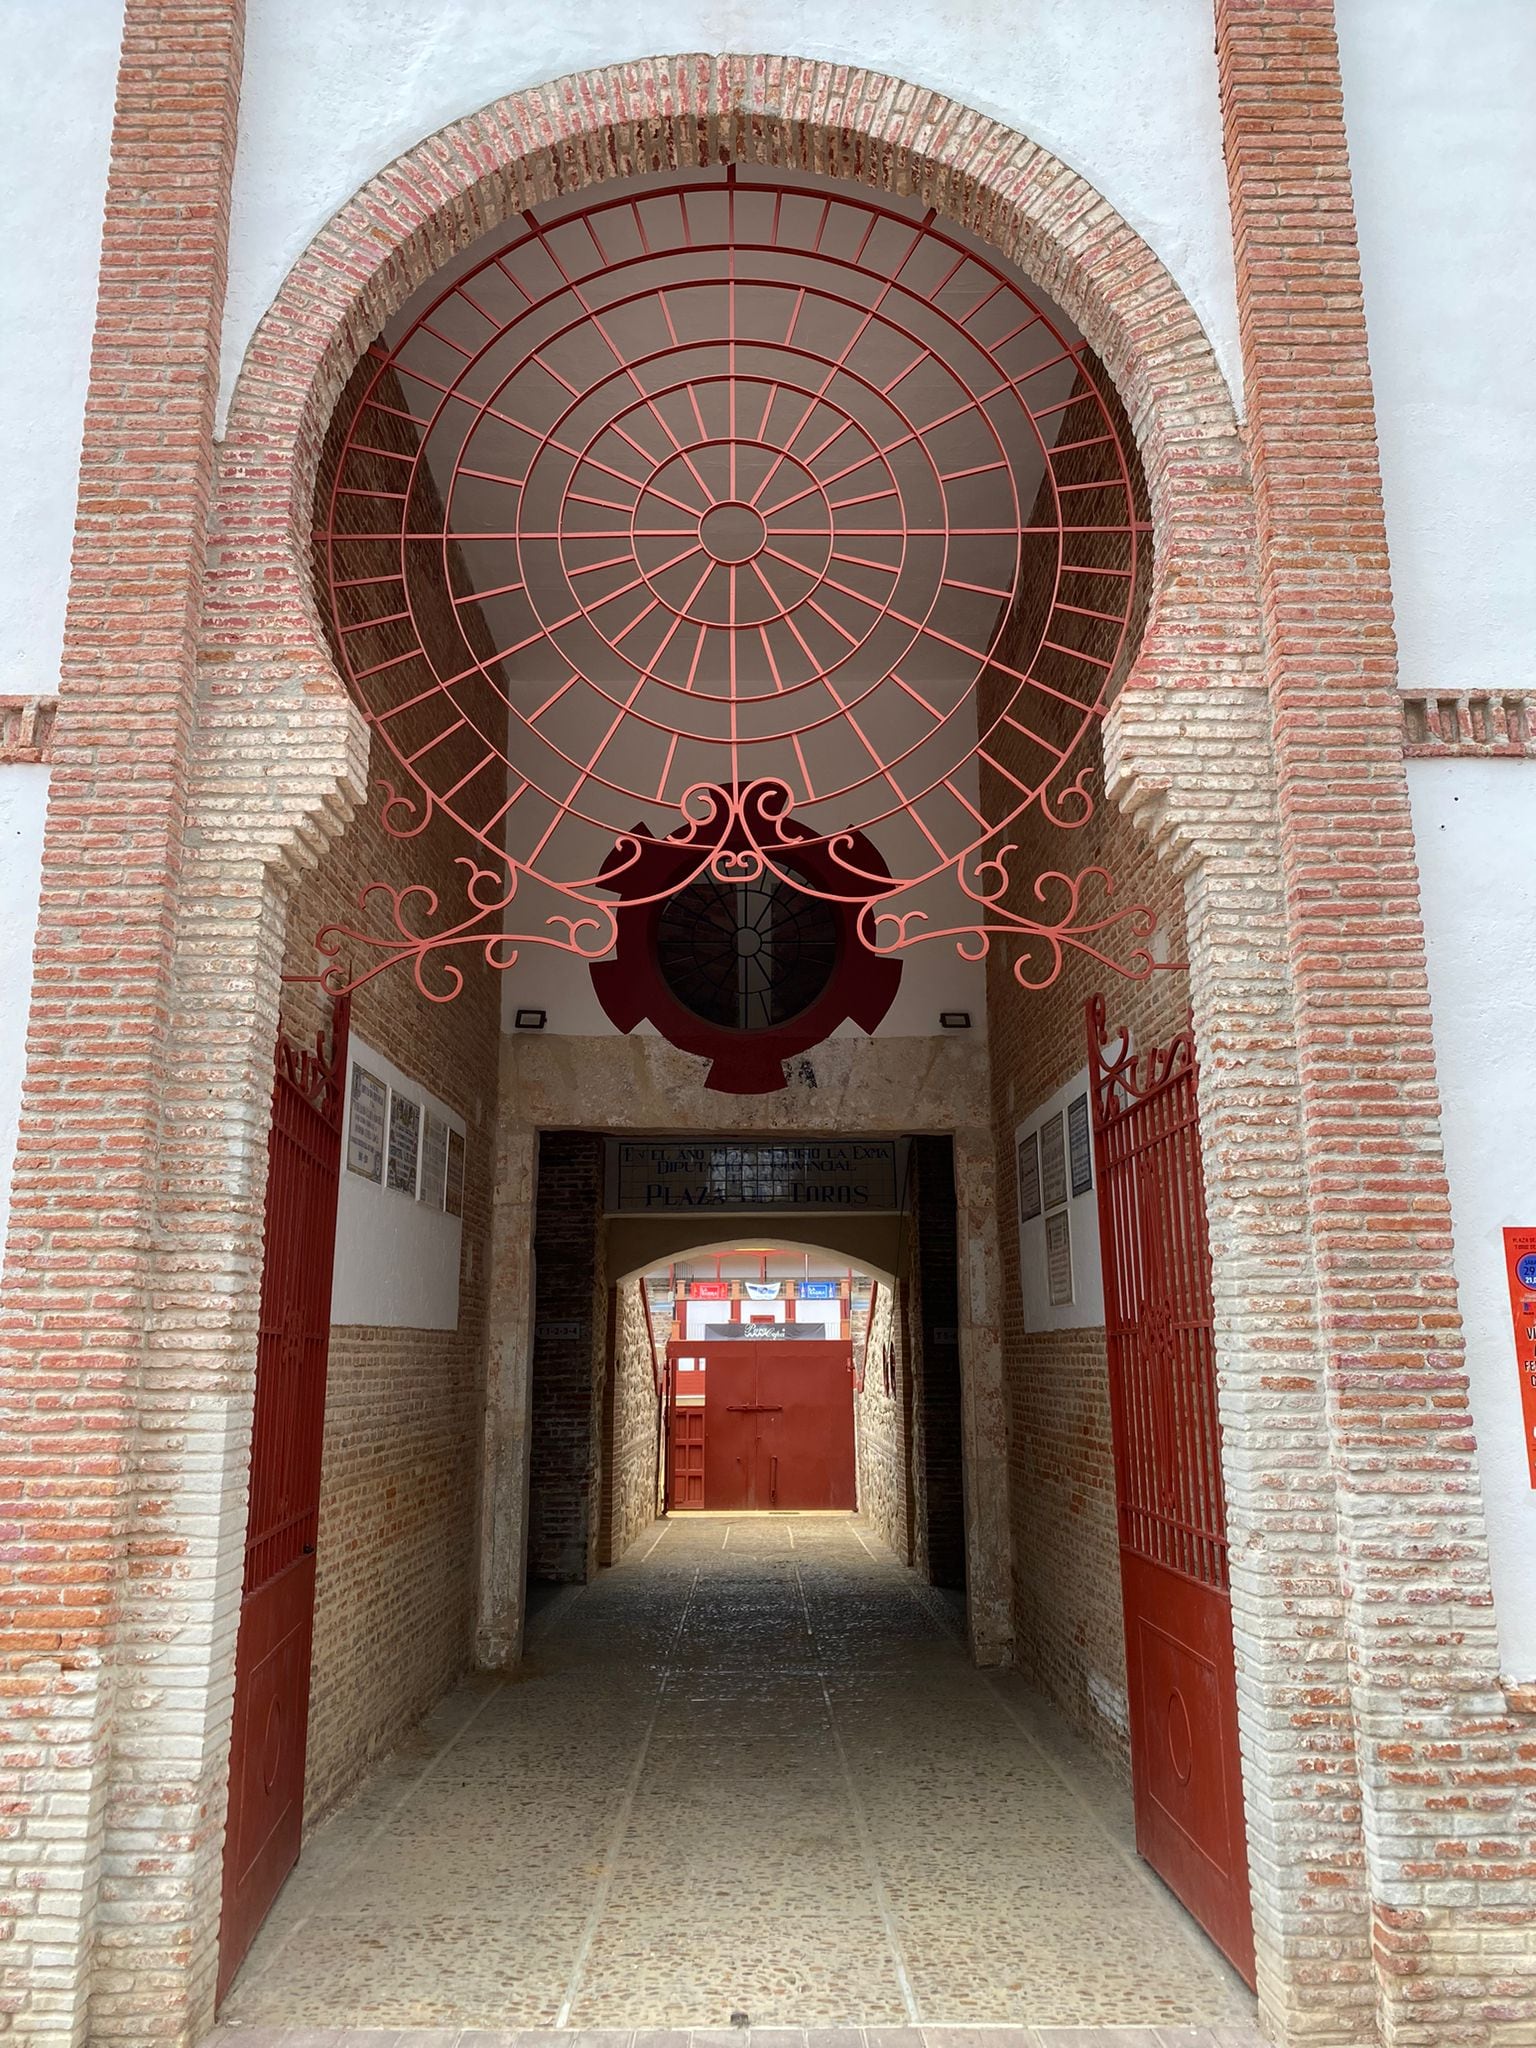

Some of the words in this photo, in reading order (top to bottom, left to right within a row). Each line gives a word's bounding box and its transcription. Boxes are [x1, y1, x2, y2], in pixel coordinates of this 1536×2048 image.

[651, 1150, 669, 1160] EL
[827, 1149, 847, 1159] LA
[646, 1184, 725, 1206] PLAZA
[790, 1182, 869, 1204] TOROS
[1523, 1266, 1536, 1276] 29
